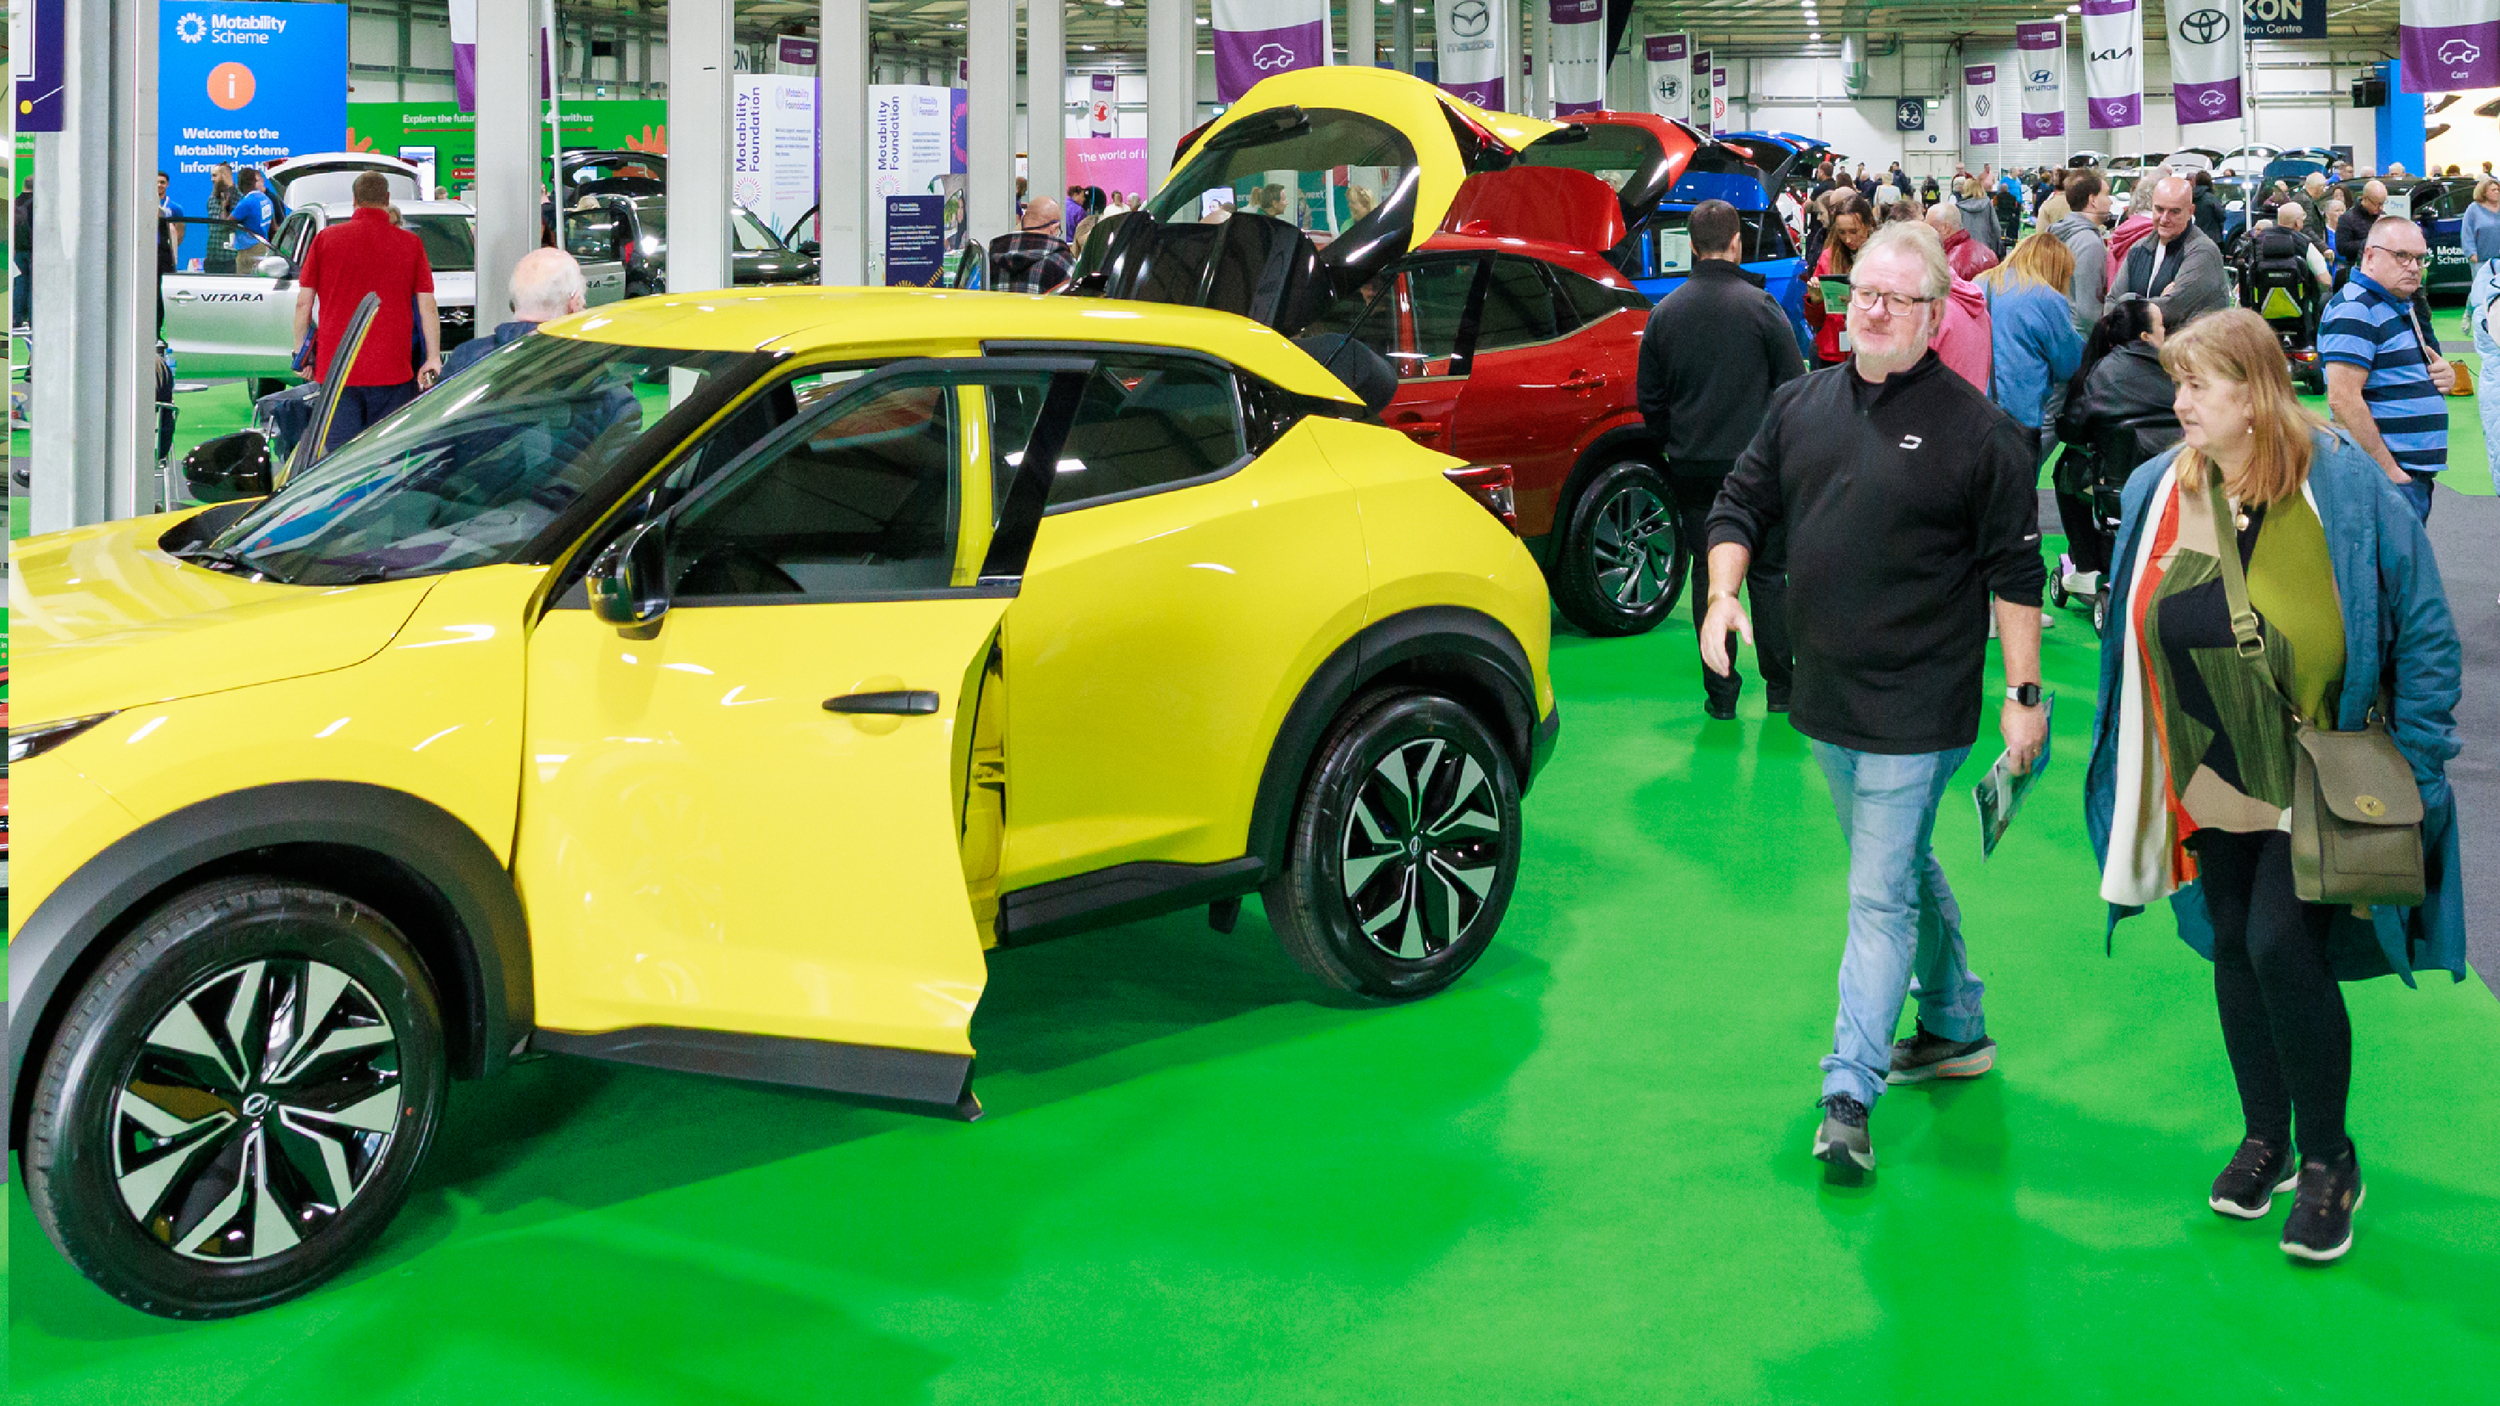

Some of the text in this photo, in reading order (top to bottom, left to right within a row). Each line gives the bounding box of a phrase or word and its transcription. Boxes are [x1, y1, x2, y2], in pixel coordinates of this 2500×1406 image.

[212, 14, 286, 33] Motability
[2267, 24, 2302, 33] Centre
[212, 30, 269, 44] Scheme
[2090, 47, 2132, 62] KIA
[403, 114, 436, 124] Explore
[438, 114, 452, 123] the
[562, 113, 582, 122] with
[183, 128, 279, 139] Welcome to the
[736, 93, 750, 172] Motability
[749, 87, 760, 172] Foundation
[878, 101, 890, 170] Motability
[890, 96, 899, 170] Foundation
[174, 145, 289, 158] Motability Scheme
[1078, 153, 1096, 163] The
[1100, 150, 1126, 161] world
[1129, 149, 1139, 159] of
[181, 161, 253, 173] Infortion
[201, 293, 264, 302] VITARA
